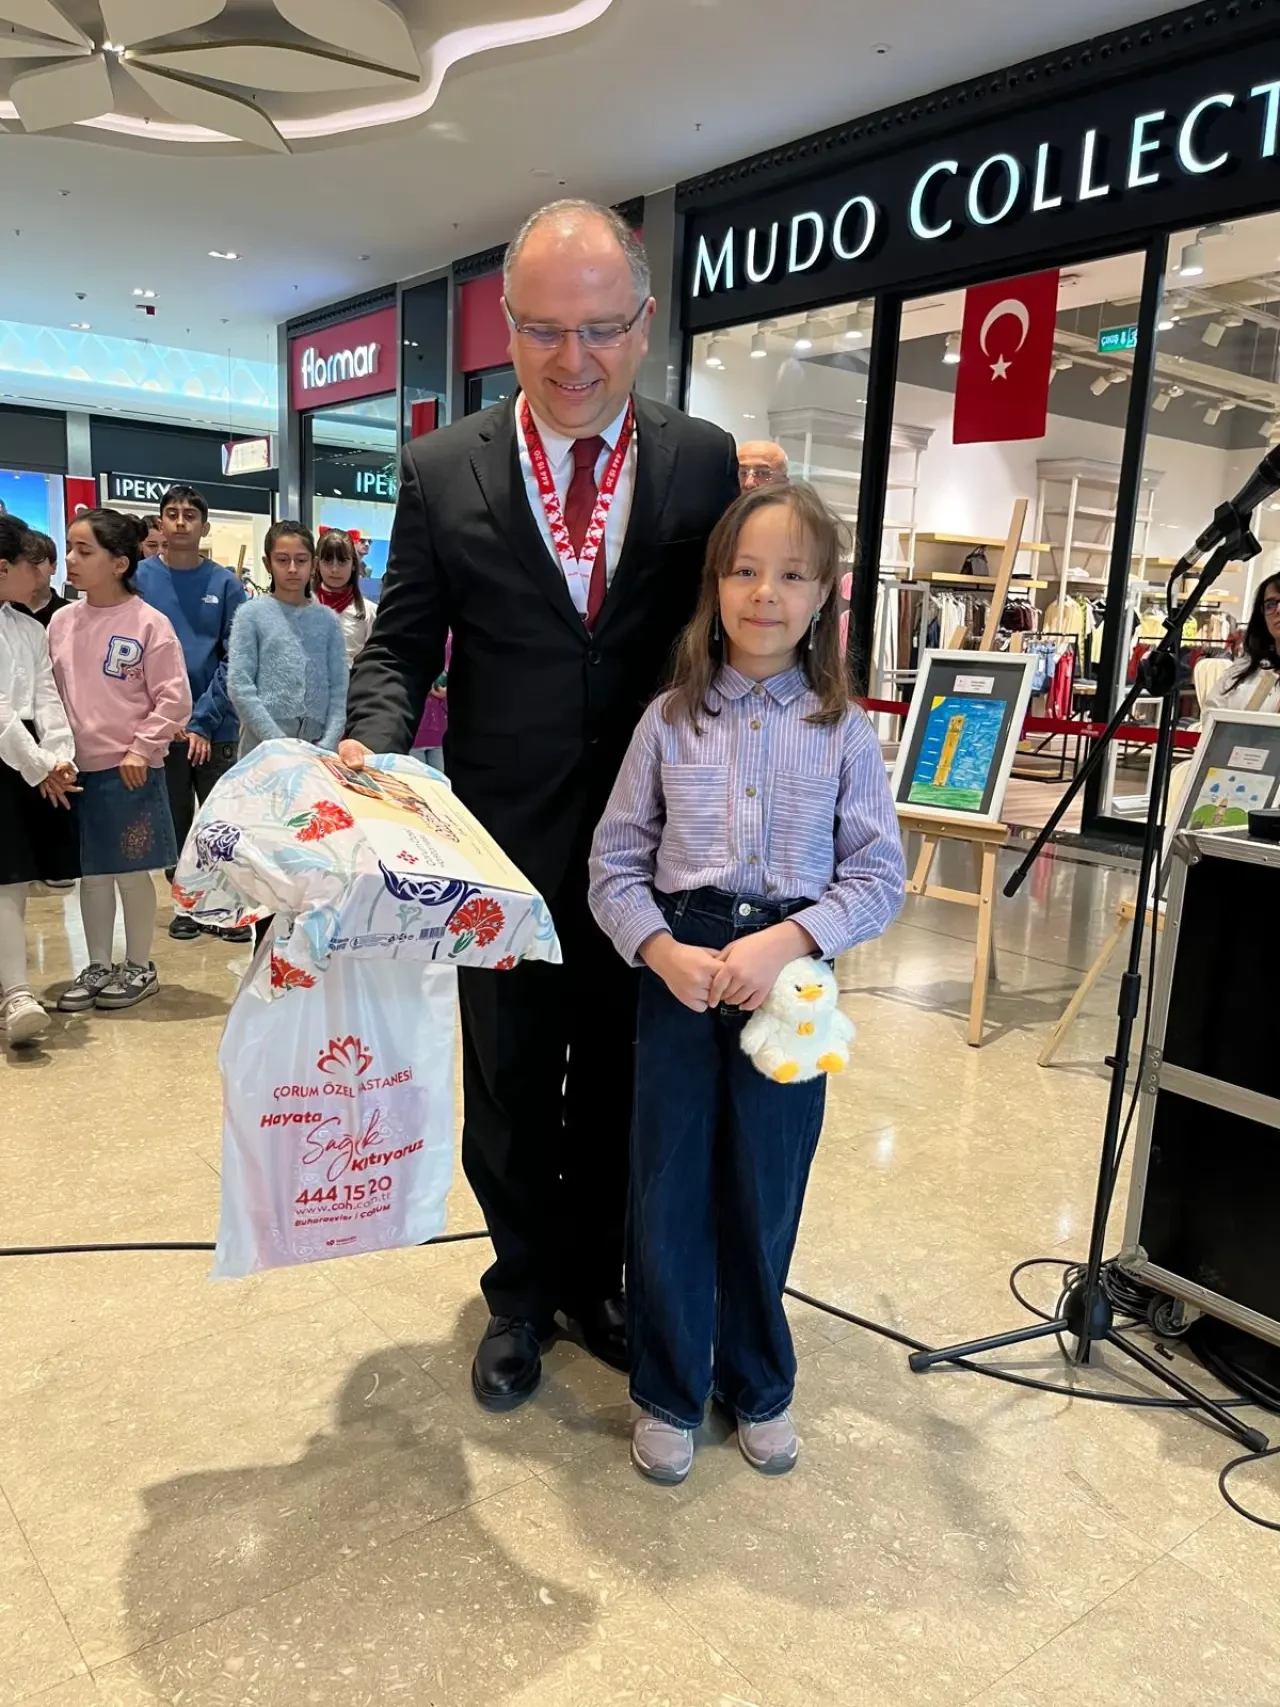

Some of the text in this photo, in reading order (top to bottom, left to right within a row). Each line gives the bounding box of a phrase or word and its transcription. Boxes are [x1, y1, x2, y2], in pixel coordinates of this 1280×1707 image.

[692, 80, 1280, 298] MUDO COLLECT
[301, 342, 377, 390] flormar
[115, 478, 193, 500] IPEKY
[103, 635, 144, 680] P
[273, 1066, 413, 1101] ÇORUM ÖZEL ASTANESİ
[260, 1111, 323, 1128] Hayata
[351, 1139, 424, 1171] Ktıyoruz
[295, 1175, 392, 1205] 444 15 20
